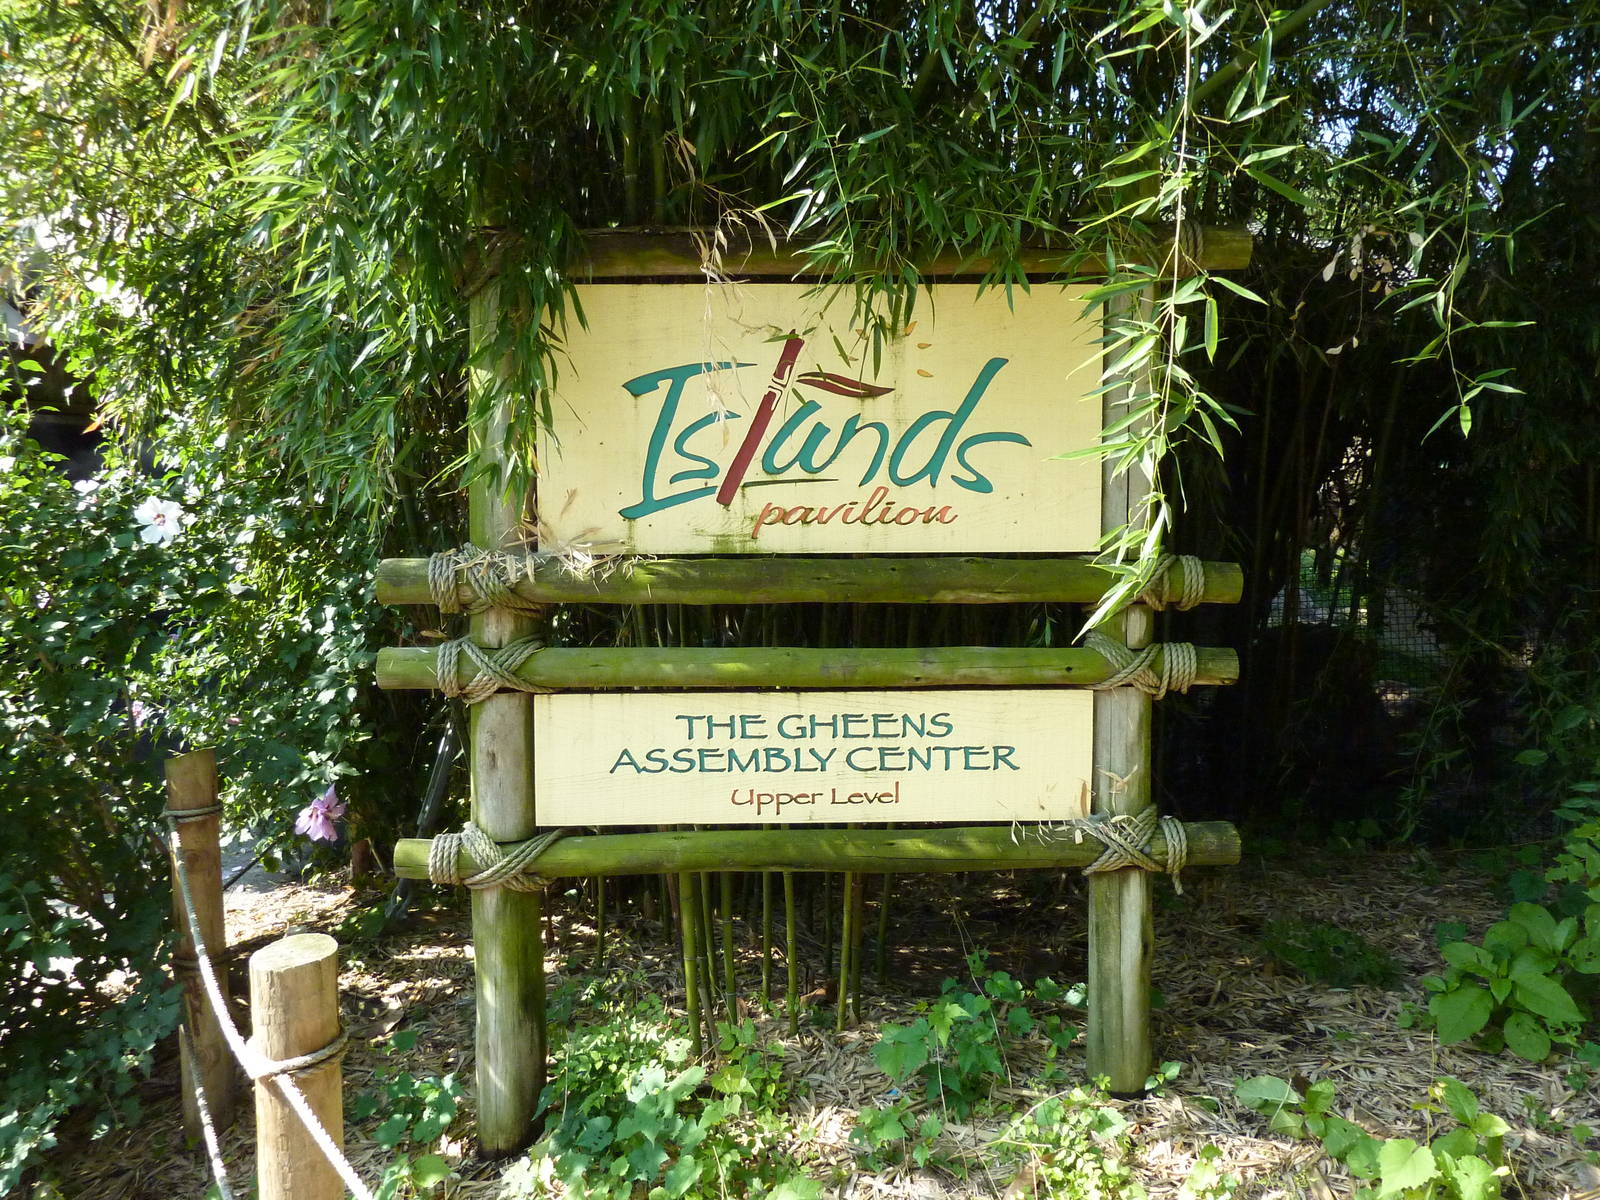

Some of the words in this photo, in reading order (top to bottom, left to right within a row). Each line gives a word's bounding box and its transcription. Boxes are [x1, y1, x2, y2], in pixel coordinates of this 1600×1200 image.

[619, 329, 1032, 519] Islands
[751, 485, 959, 539] pavilion
[675, 713, 768, 741] THE
[777, 712, 954, 740] GHEENS
[609, 747, 837, 774] ASSEMBLY
[845, 745, 1020, 772] CENTER
[730, 788, 823, 816] Upper
[830, 781, 900, 806] Level
